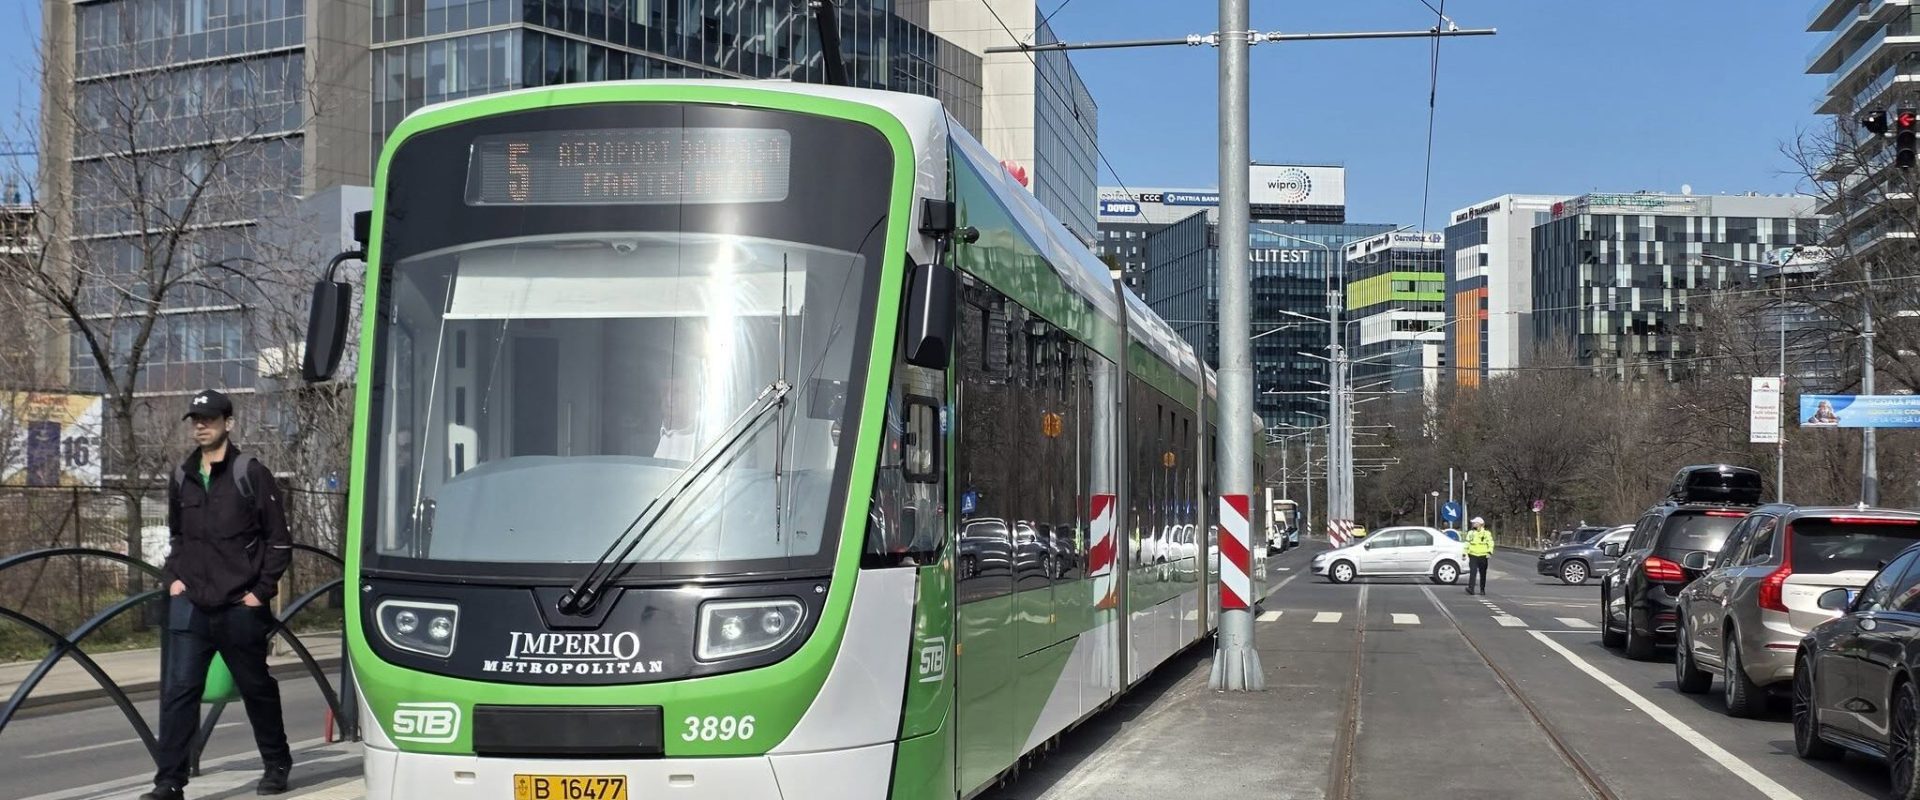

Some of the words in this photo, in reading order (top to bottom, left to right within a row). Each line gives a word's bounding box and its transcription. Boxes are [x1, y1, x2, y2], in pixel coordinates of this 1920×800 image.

[559, 141, 671, 167] AEROPORT
[509, 142, 530, 202] 5
[1267, 179, 1298, 191] wipro
[1106, 203, 1136, 213] DOVER
[1143, 194, 1161, 202] CCC
[61, 436, 90, 467] 16
[505, 631, 641, 661] IMPERIO
[482, 660, 663, 675] METROPOLITAN
[919, 644, 944, 675] STB
[392, 708, 455, 736] STB
[681, 714, 756, 741] 3896
[535, 778, 550, 800] B
[561, 778, 624, 800] 16477
